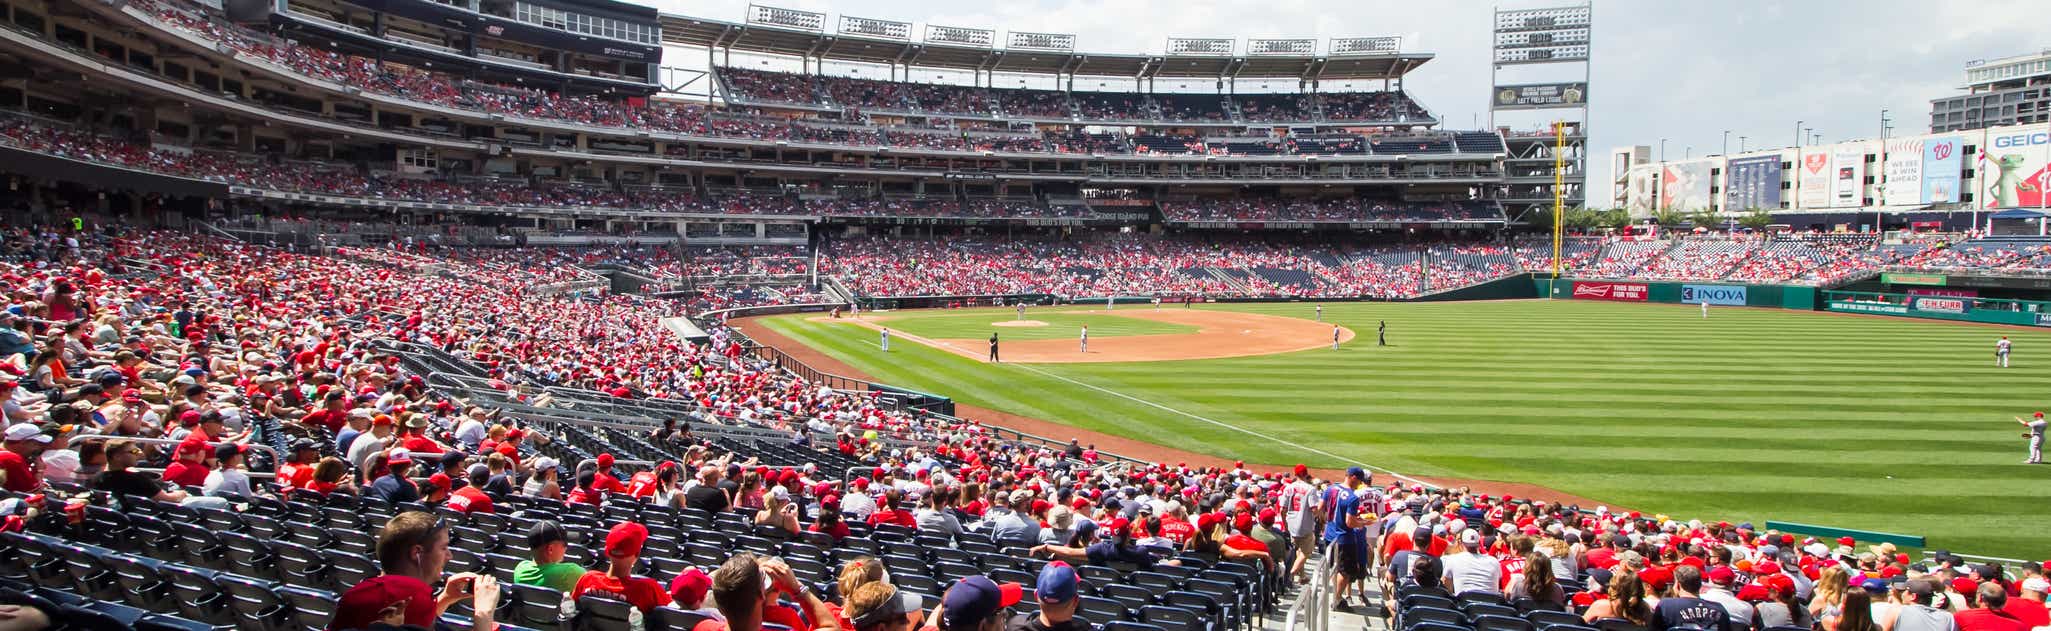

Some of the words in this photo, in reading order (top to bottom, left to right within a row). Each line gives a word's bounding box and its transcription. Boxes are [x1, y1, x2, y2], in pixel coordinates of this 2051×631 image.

[1995, 132, 2051, 148] GEIC
[1933, 141, 1953, 160] W
[1698, 288, 1744, 301] INOVA
[1939, 300, 1961, 309] FURR
[631, 482, 645, 498] 7
[1363, 503, 1378, 514] 31
[1679, 607, 1722, 621] HARPER
